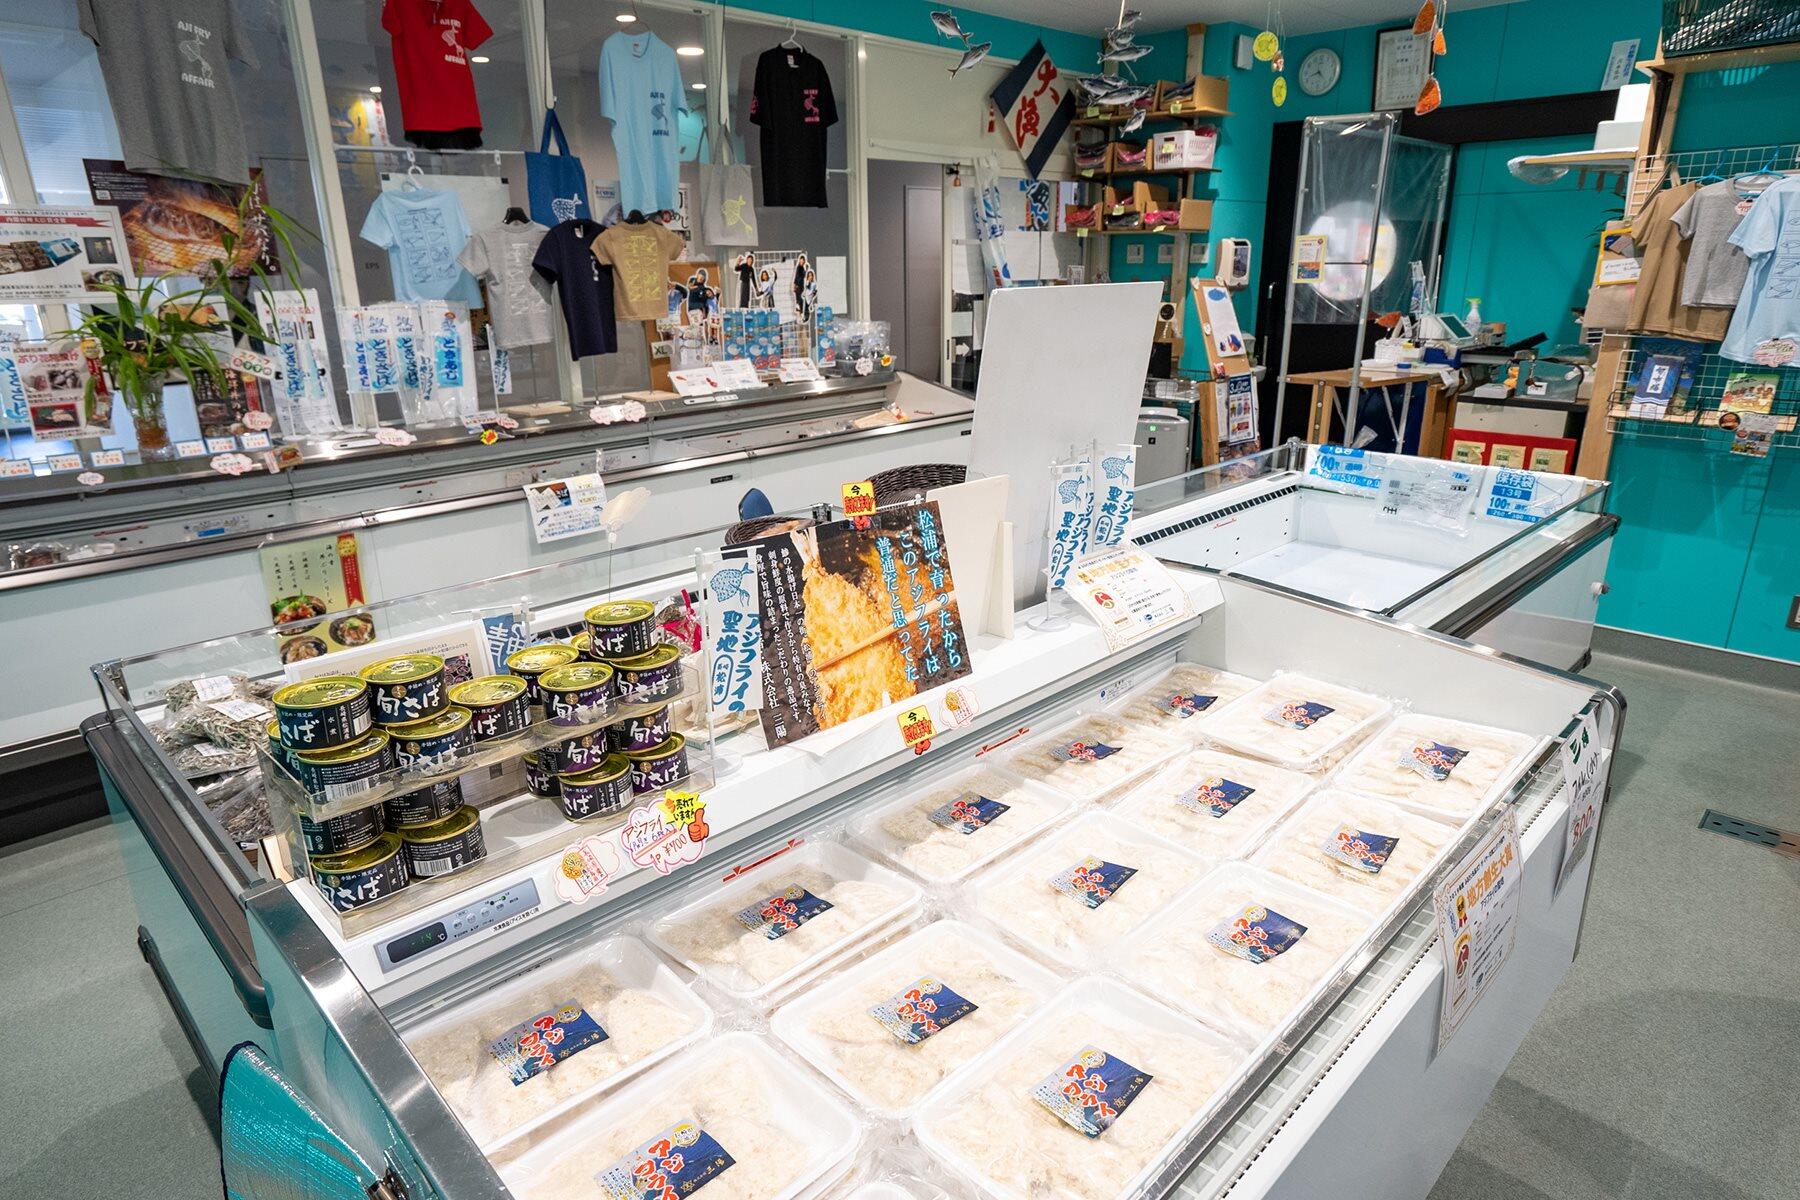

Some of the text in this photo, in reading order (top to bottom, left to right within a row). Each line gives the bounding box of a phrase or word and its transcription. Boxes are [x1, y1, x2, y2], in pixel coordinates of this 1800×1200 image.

[177, 20, 212, 39] AJI FRY
[181, 72, 215, 88] AFFAIR
[654, 345, 669, 355] XL
[851, 485, 861, 495] 今
[1496, 471, 1535, 489] 保存袋
[1501, 488, 1522, 498] 13号
[1101, 486, 1122, 516] 聖地
[1055, 511, 1076, 543] 聖地
[1054, 512, 1088, 588] アジフライの
[900, 531, 941, 675] このアジフライは
[917, 509, 962, 669] 松浦で育ったから
[876, 536, 920, 682] 普通だと思ってた
[716, 610, 743, 653] 聖地
[729, 613, 760, 712] アジフライの
[377, 681, 442, 719] 旬さば
[760, 661, 780, 710] 株式会社
[908, 711, 918, 721] 今
[675, 798, 695, 811] 売れて
[623, 814, 662, 844] アジフライ
[664, 833, 688, 856] ¥700
[1467, 842, 1513, 908] 地方創生大賞
[904, 988, 937, 1013] アジ
[533, 1015, 565, 1045] アジ
[897, 1002, 941, 1032] フライ
[519, 1031, 557, 1066] フライ
[1066, 1064, 1107, 1092] アジ
[1063, 1081, 1118, 1118] フライ
[648, 1138, 685, 1173] アジ
[634, 1159, 680, 1200] フライ
